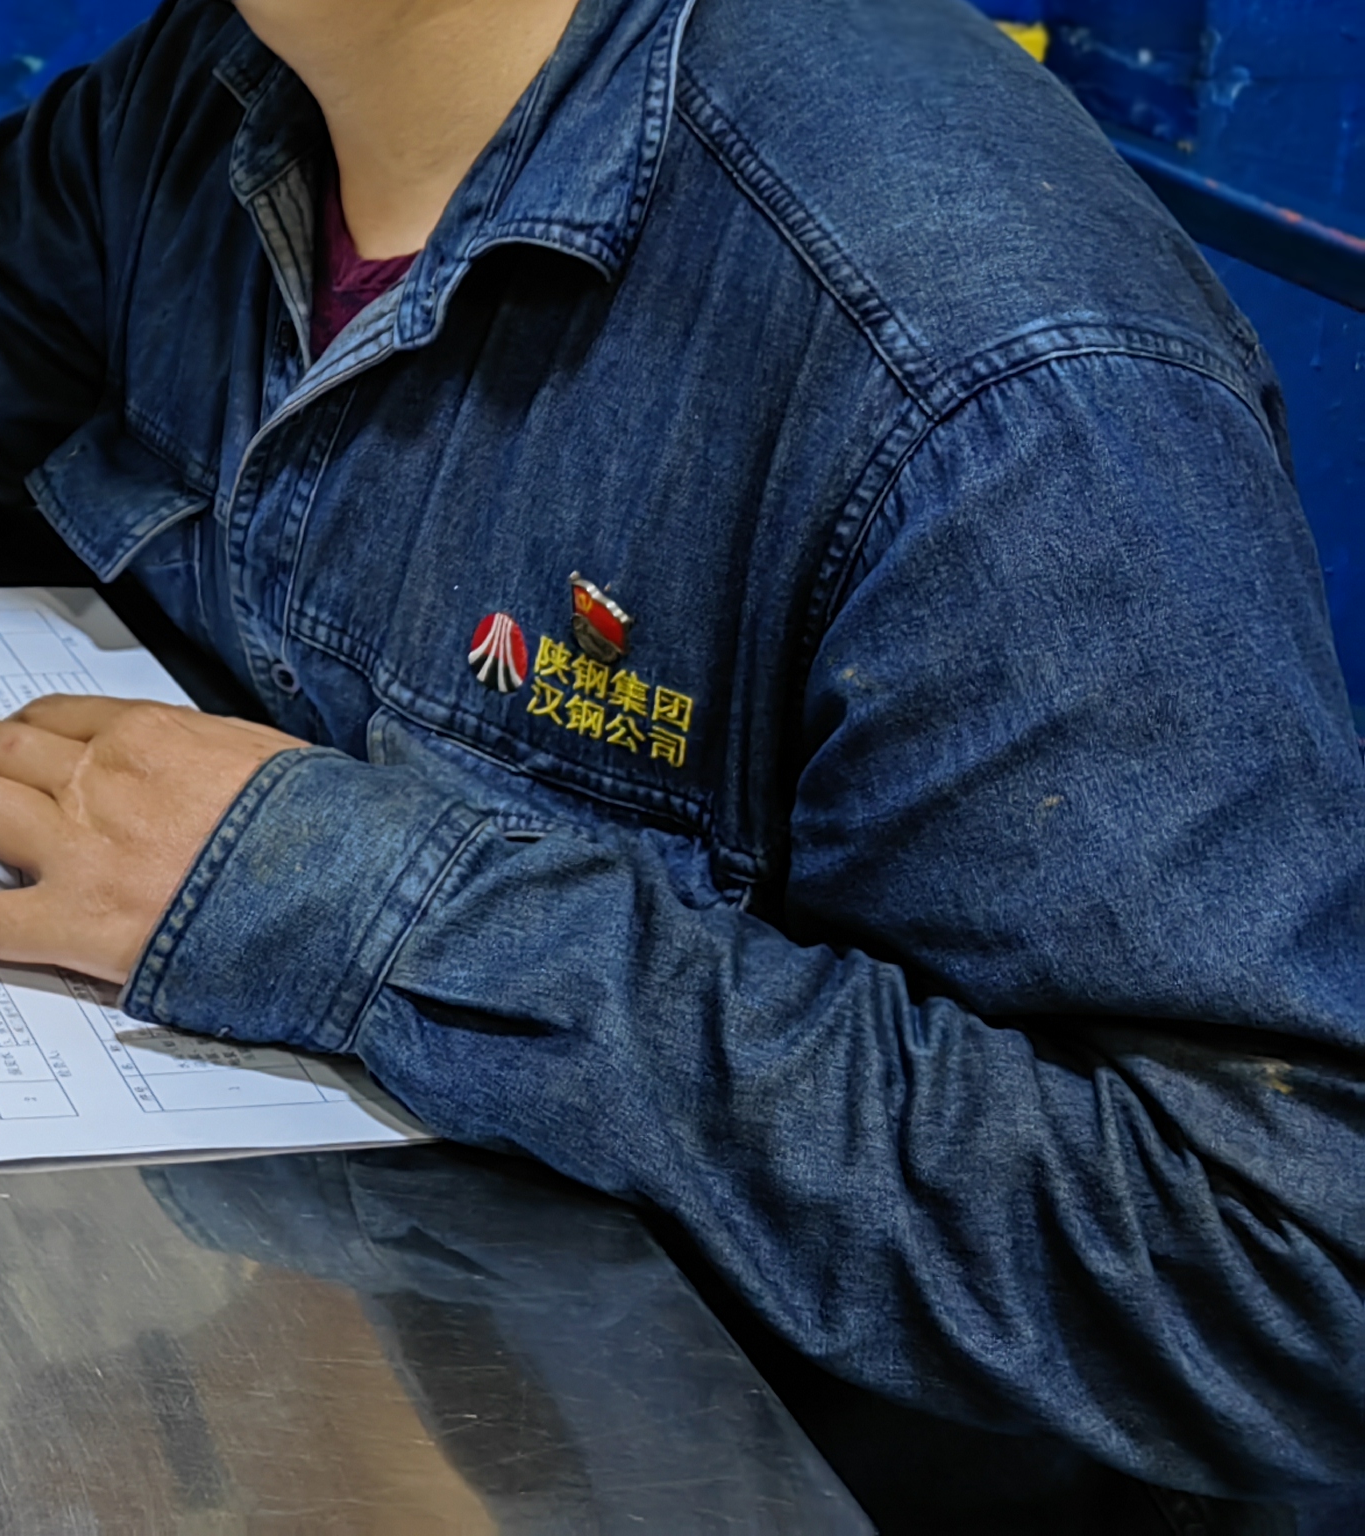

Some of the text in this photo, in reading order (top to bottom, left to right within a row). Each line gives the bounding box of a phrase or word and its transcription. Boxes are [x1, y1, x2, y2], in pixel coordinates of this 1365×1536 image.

[526, 677, 687, 768] 汉钢公司
[534, 635, 693, 732] 陕钢集团
